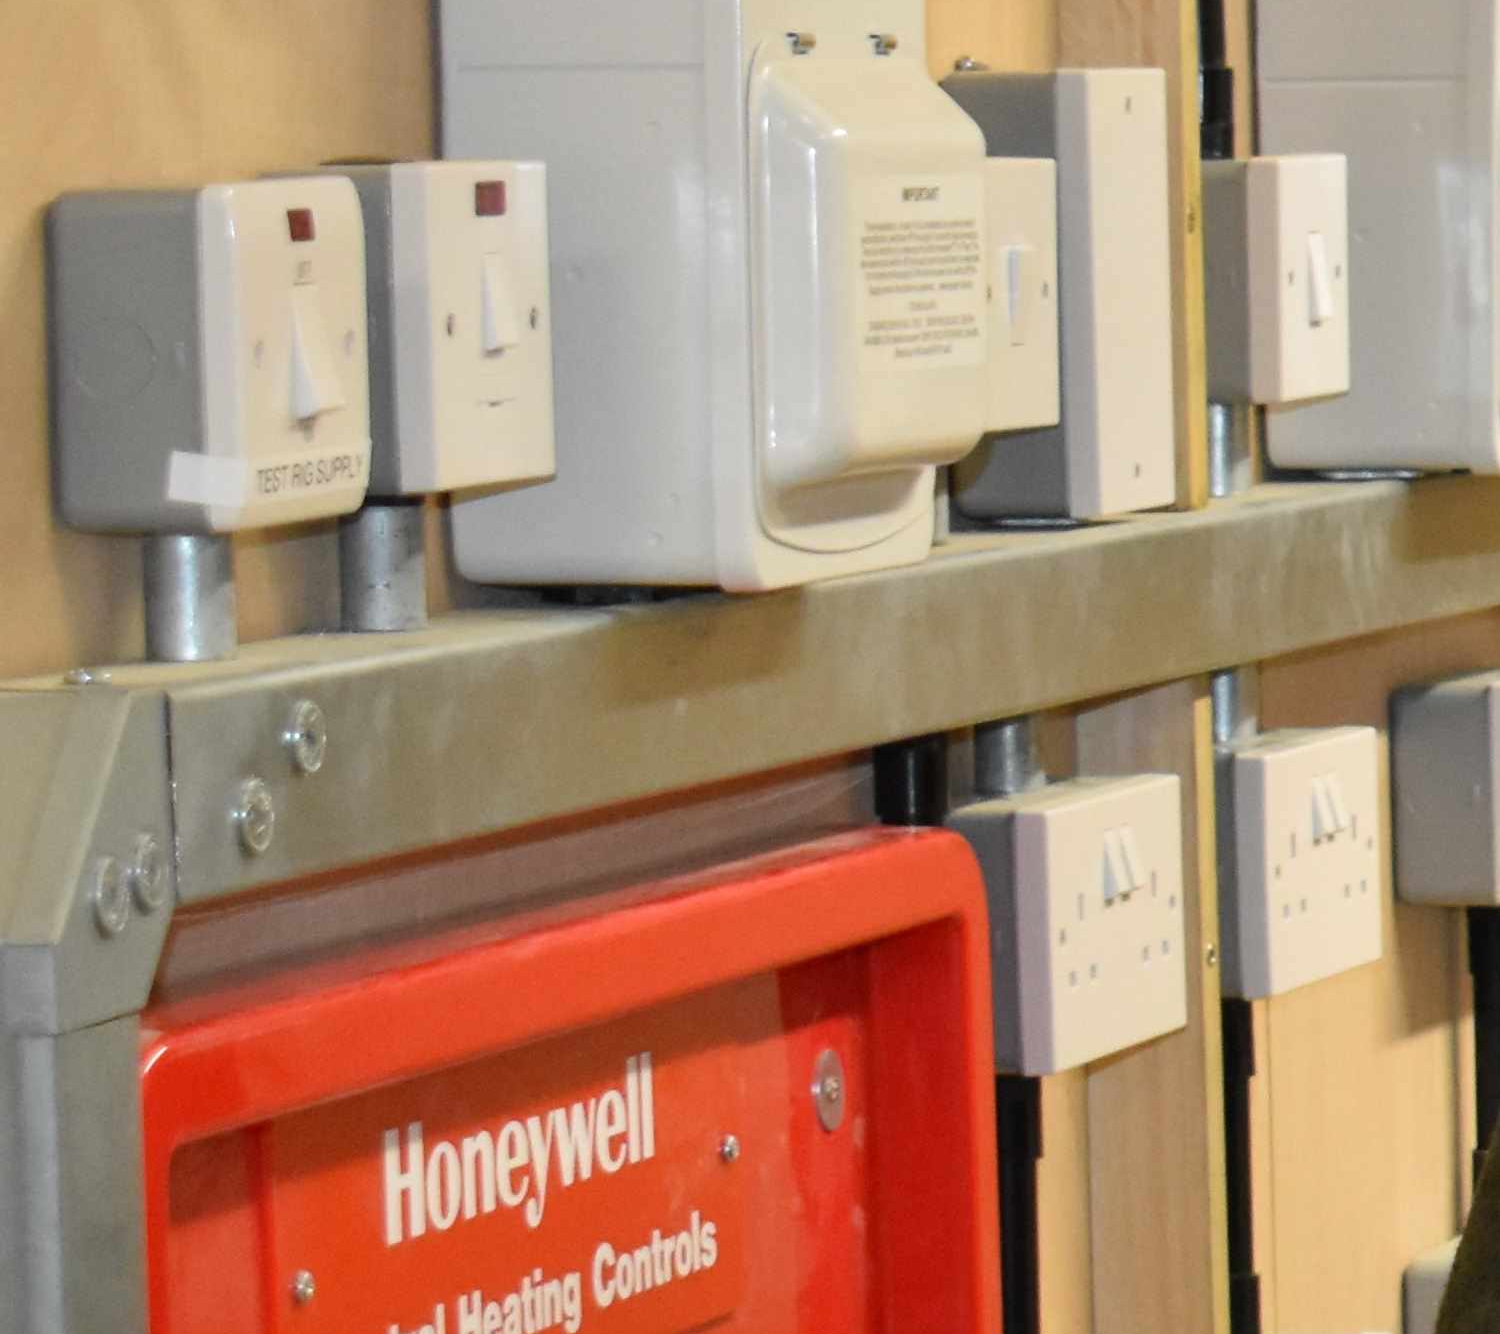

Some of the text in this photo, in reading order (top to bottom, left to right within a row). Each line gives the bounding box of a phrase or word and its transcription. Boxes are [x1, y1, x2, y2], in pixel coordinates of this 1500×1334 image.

[257, 466, 290, 494] TEST
[291, 461, 315, 487] RIG
[383, 1051, 655, 1247] Honeywell
[592, 1210, 718, 1309] Controls
